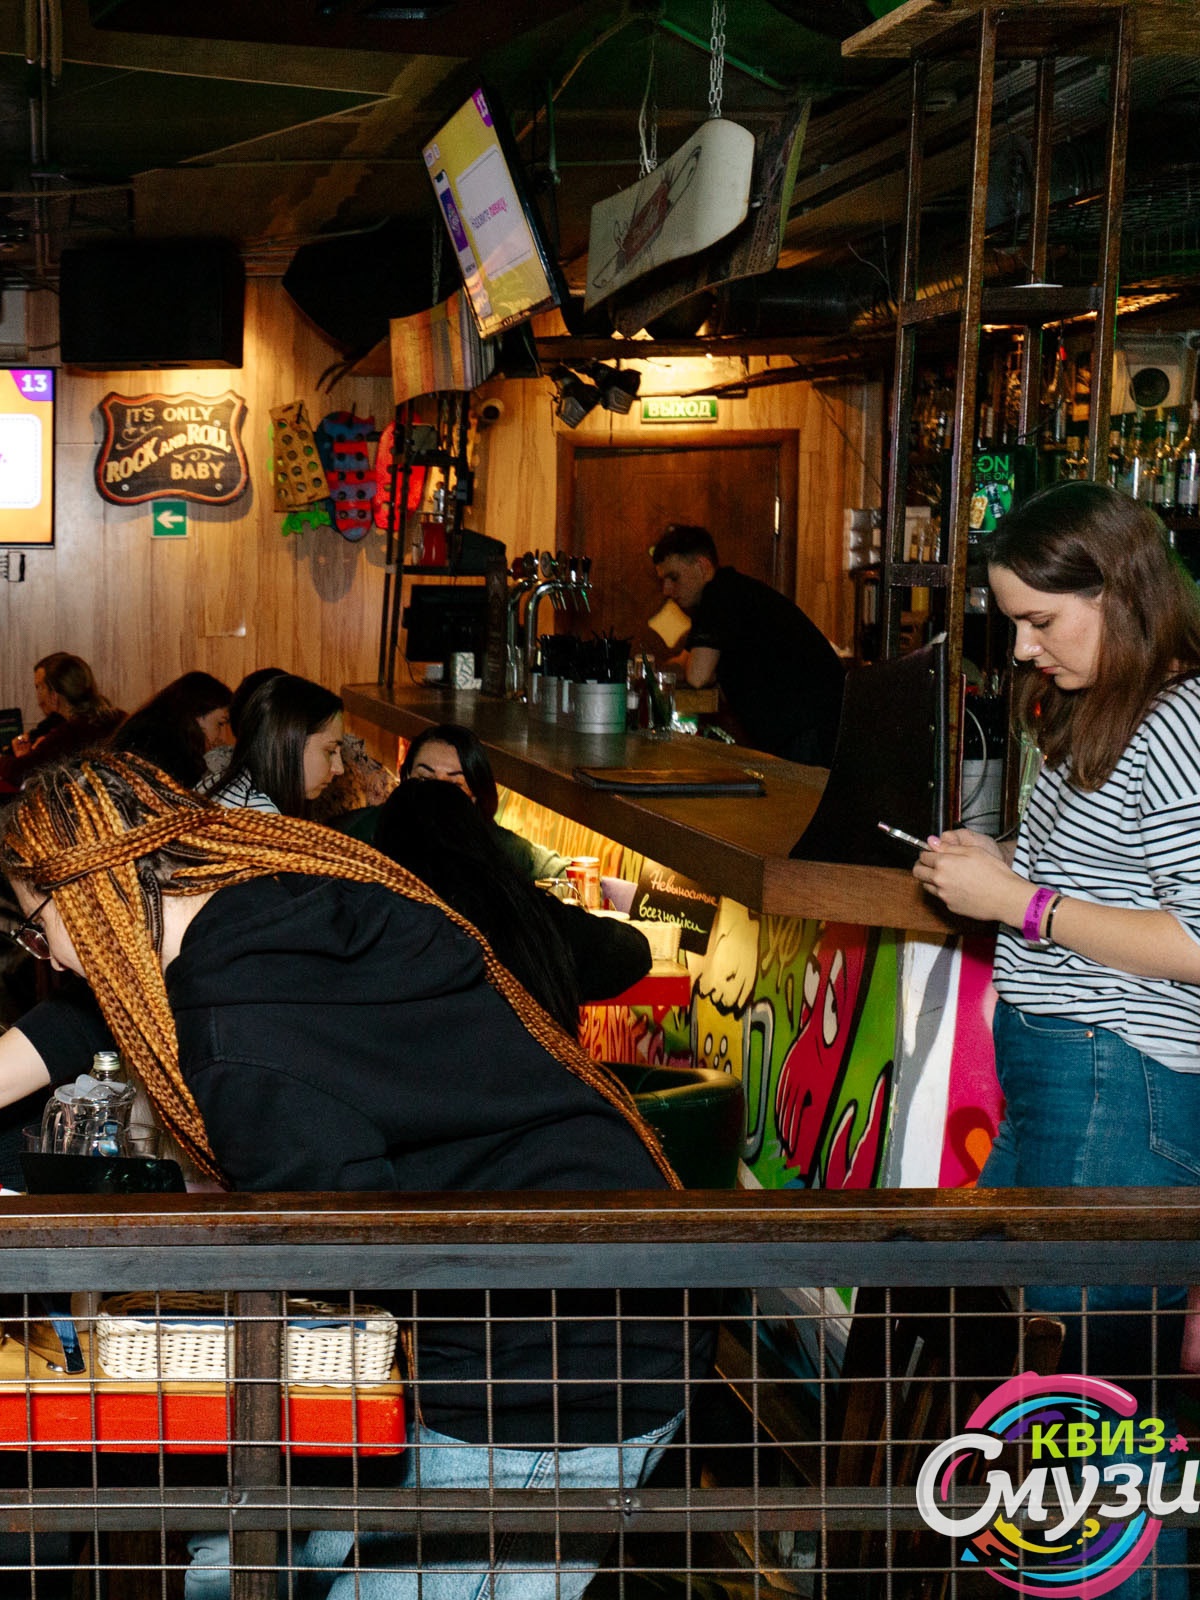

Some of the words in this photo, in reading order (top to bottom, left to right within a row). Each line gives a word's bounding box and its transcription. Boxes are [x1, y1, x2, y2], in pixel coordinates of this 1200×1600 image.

[21, 374, 47, 392] 13
[125, 407, 155, 425] IT'S
[162, 406, 214, 422] ONLY
[648, 401, 711, 417] ВЫХОД
[105, 437, 159, 483] ROCK
[159, 433, 187, 457] AND
[186, 423, 231, 453] ROLL
[170, 461, 225, 480] BABY
